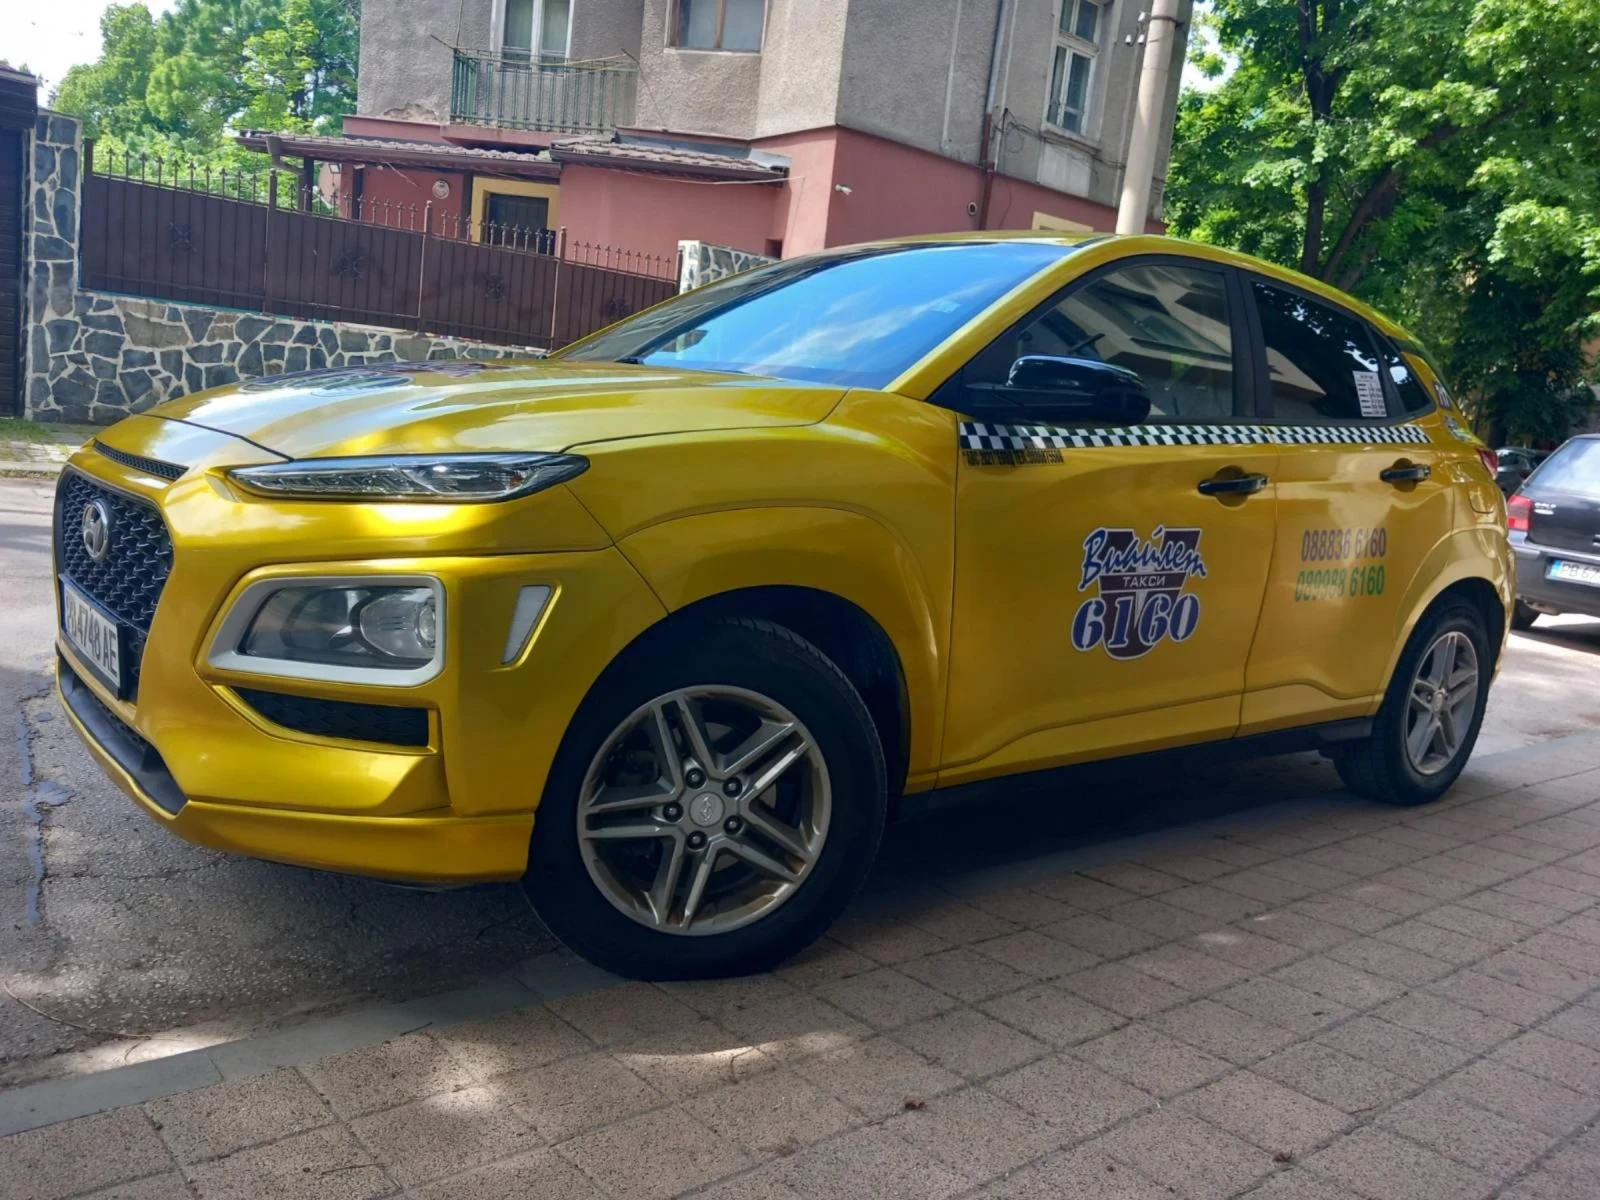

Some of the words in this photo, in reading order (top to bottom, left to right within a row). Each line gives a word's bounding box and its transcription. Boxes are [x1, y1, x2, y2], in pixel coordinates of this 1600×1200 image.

[1355, 527, 1387, 559] 6160
[1122, 575, 1166, 588] ТАКСИ
[1349, 564, 1385, 597] 6160
[1072, 593, 1200, 651] 6160
